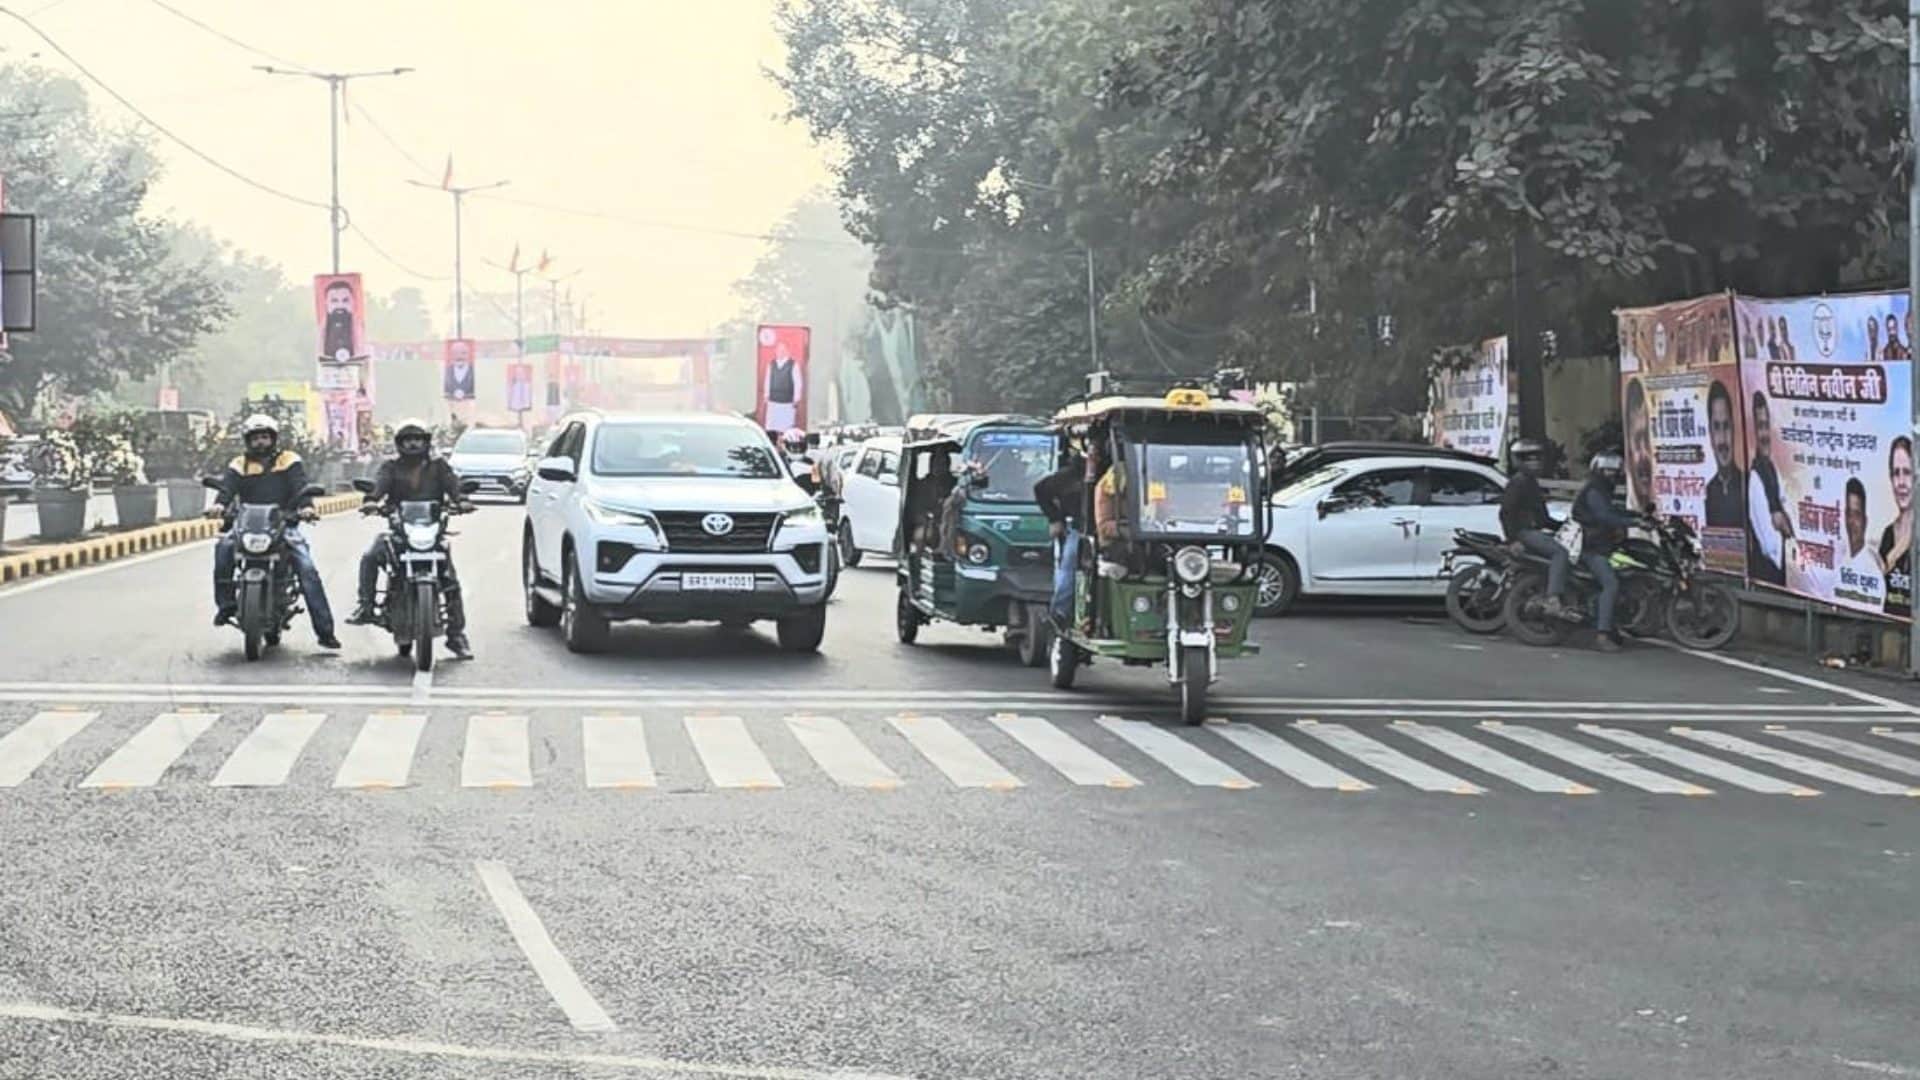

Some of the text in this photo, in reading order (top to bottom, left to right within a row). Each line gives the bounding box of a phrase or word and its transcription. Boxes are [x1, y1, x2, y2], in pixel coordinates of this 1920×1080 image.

[1769, 365, 1882, 400] श्री नितिन नवीन जी
